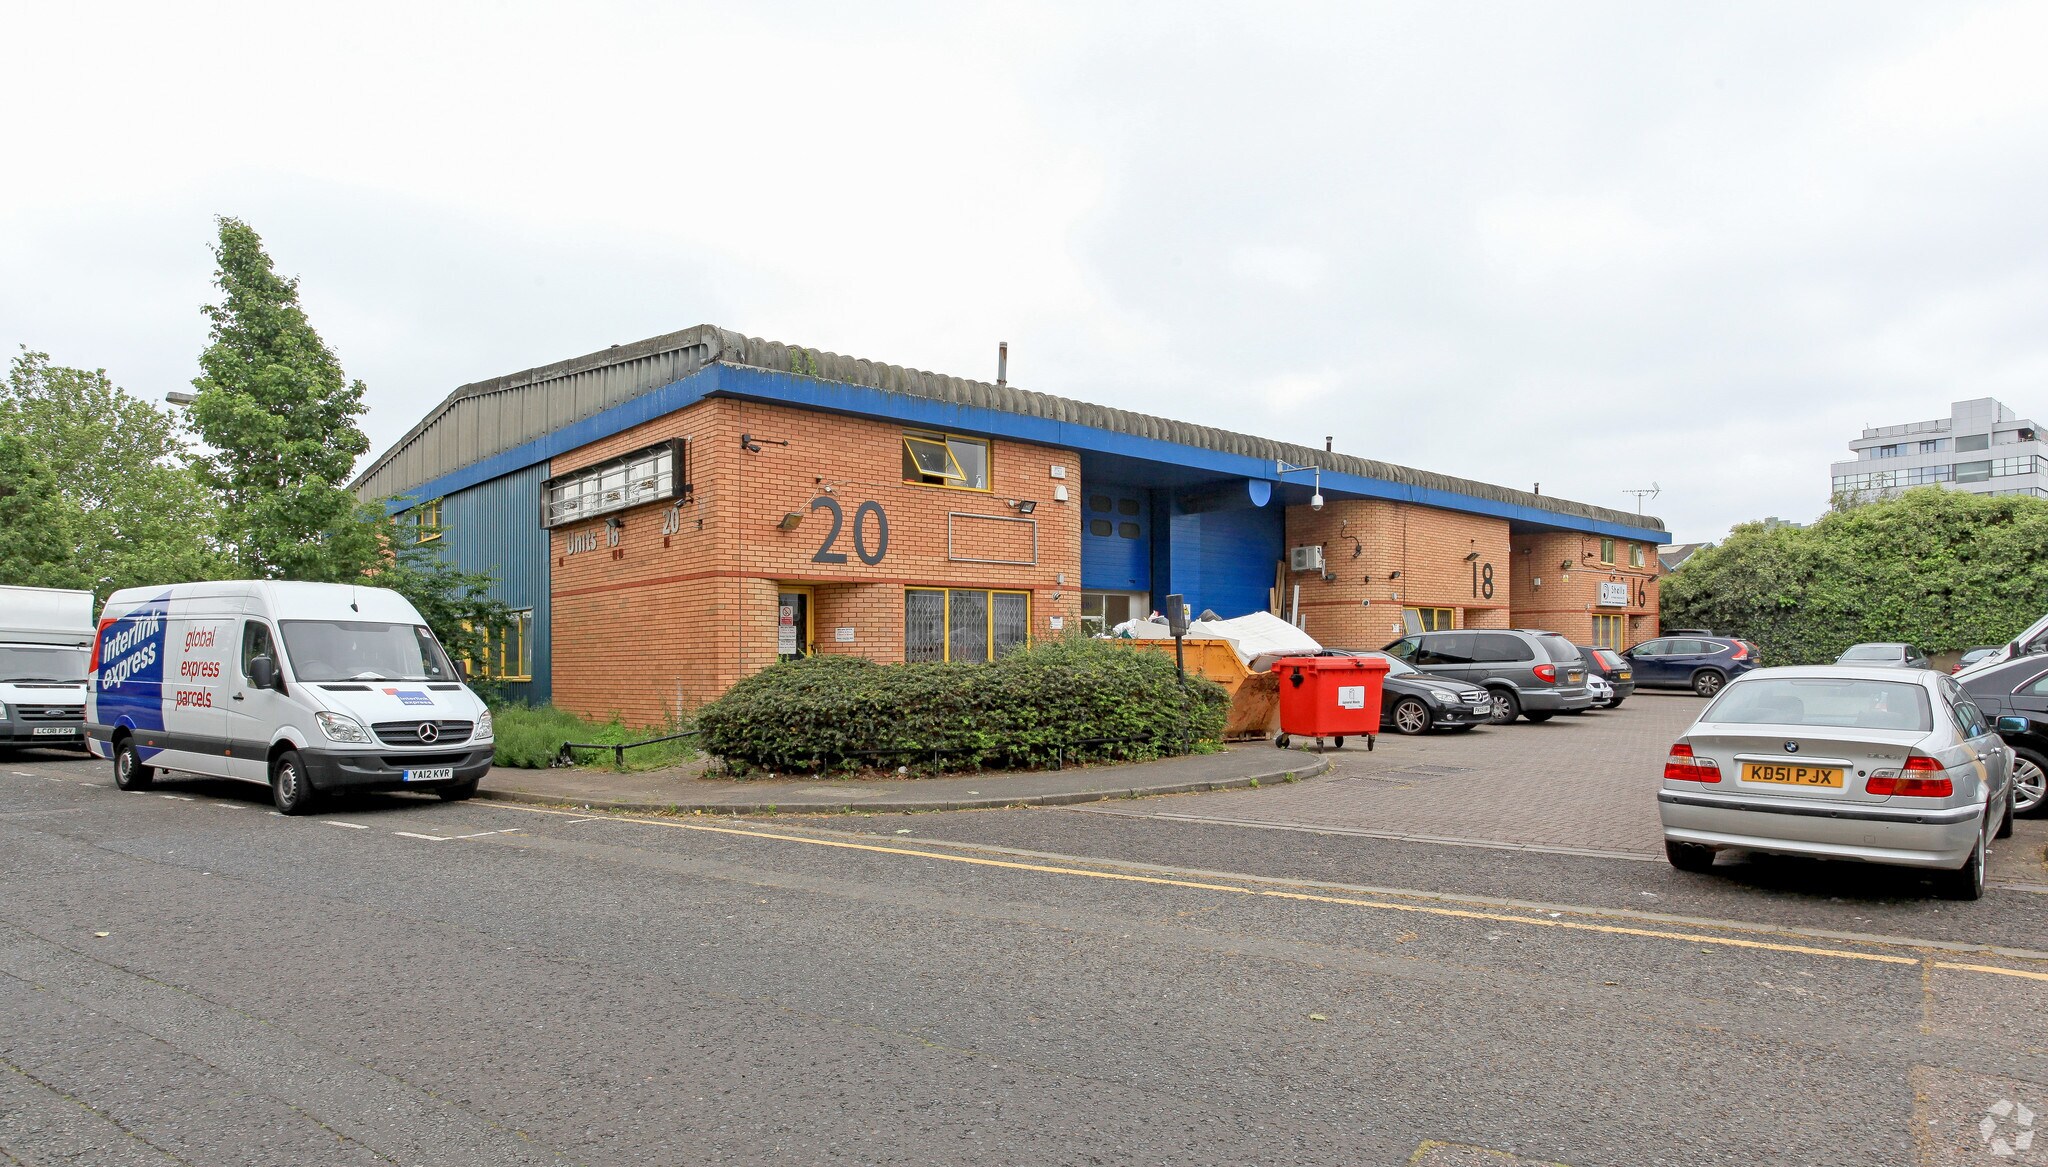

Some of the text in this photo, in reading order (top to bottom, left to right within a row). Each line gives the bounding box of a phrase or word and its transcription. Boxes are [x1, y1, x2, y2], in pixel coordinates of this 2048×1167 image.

[566, 507, 680, 555] Units 16 20
[811, 496, 888, 565] 20
[1473, 561, 1494, 600] 18
[1632, 578, 1646, 608] 16
[103, 607, 160, 664] interlink
[184, 626, 217, 652] global
[102, 642, 157, 690] express
[180, 660, 220, 682] express
[174, 687, 212, 711] parcels
[412, 768, 450, 779] YA12 KVR
[1751, 766, 1832, 785] KD51 PJX
